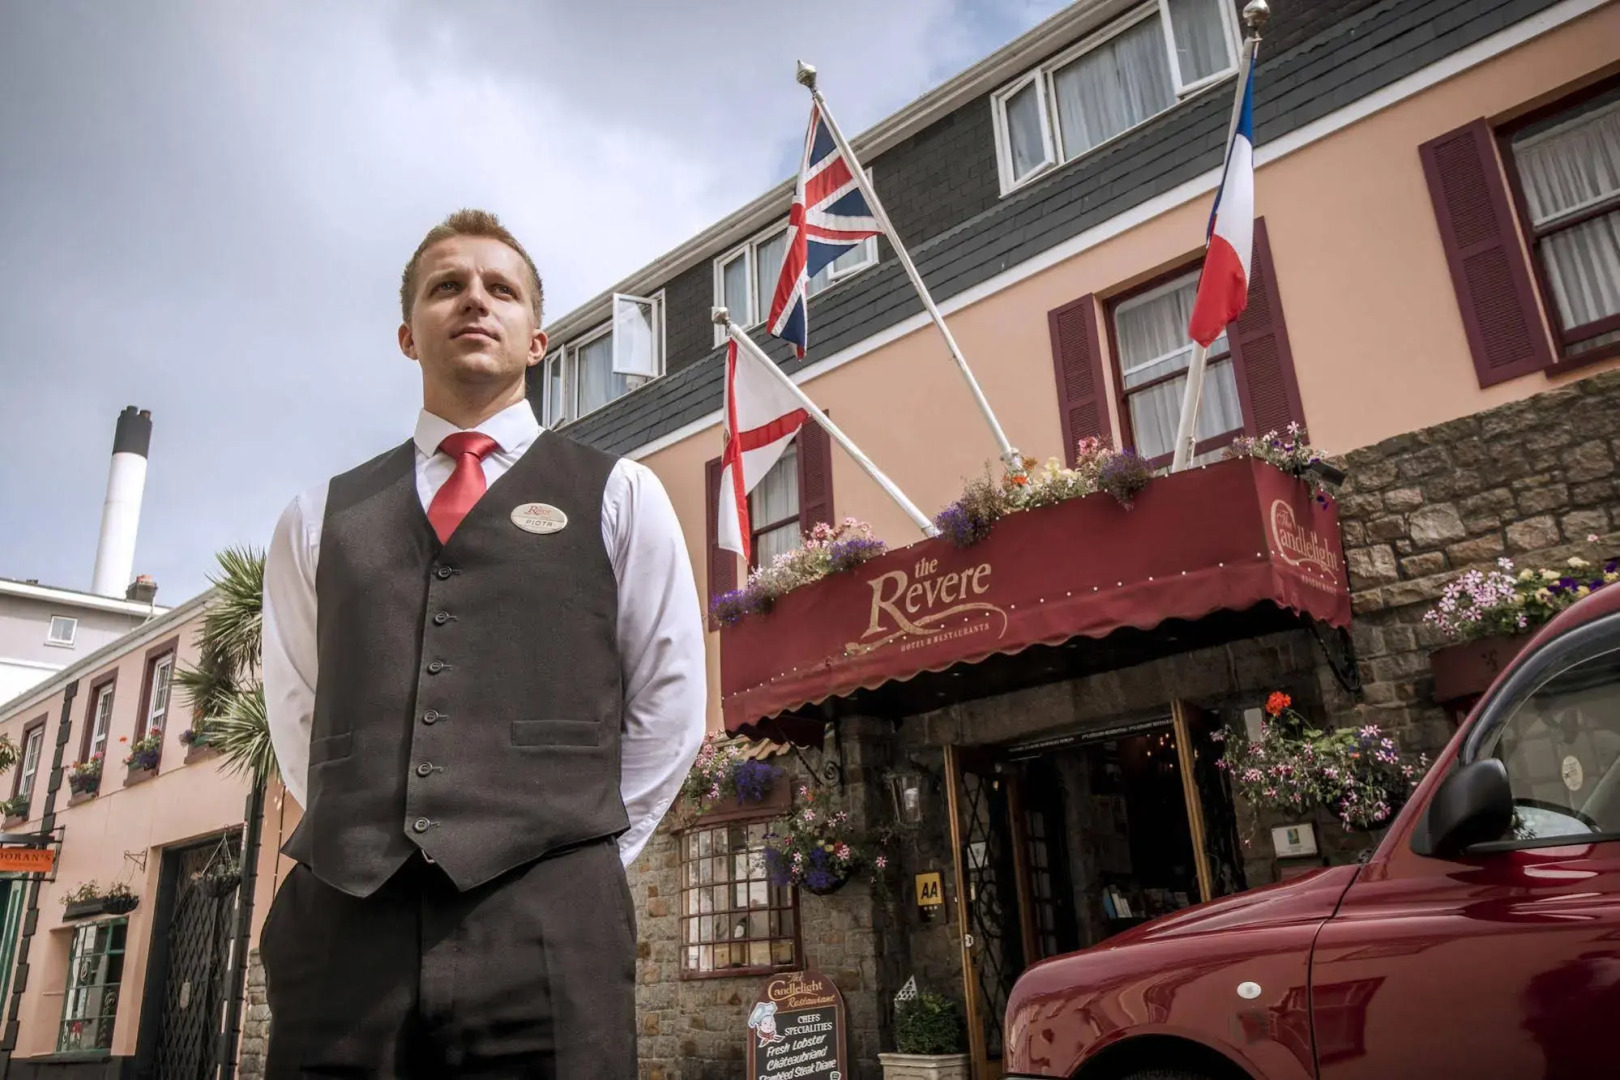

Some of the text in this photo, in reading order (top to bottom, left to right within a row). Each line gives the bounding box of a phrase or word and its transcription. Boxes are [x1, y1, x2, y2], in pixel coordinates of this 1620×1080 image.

[1271, 499, 1339, 573] Candlelight
[914, 557, 938, 579] the
[860, 563, 992, 639] Revere
[901, 640, 925, 652] HOTEL
[933, 623, 990, 643] RESTAURANTS
[920, 881, 938, 900] AA
[768, 979, 823, 1001] Candlelight
[787, 994, 836, 1008] Restaurant
[784, 1022, 833, 1036] SPECIALITIES
[797, 1013, 821, 1024] CHEFS
[766, 1034, 827, 1058] Fresh Lobster
[793, 1063, 815, 1077] Steak
[815, 1059, 837, 1072] Diane
